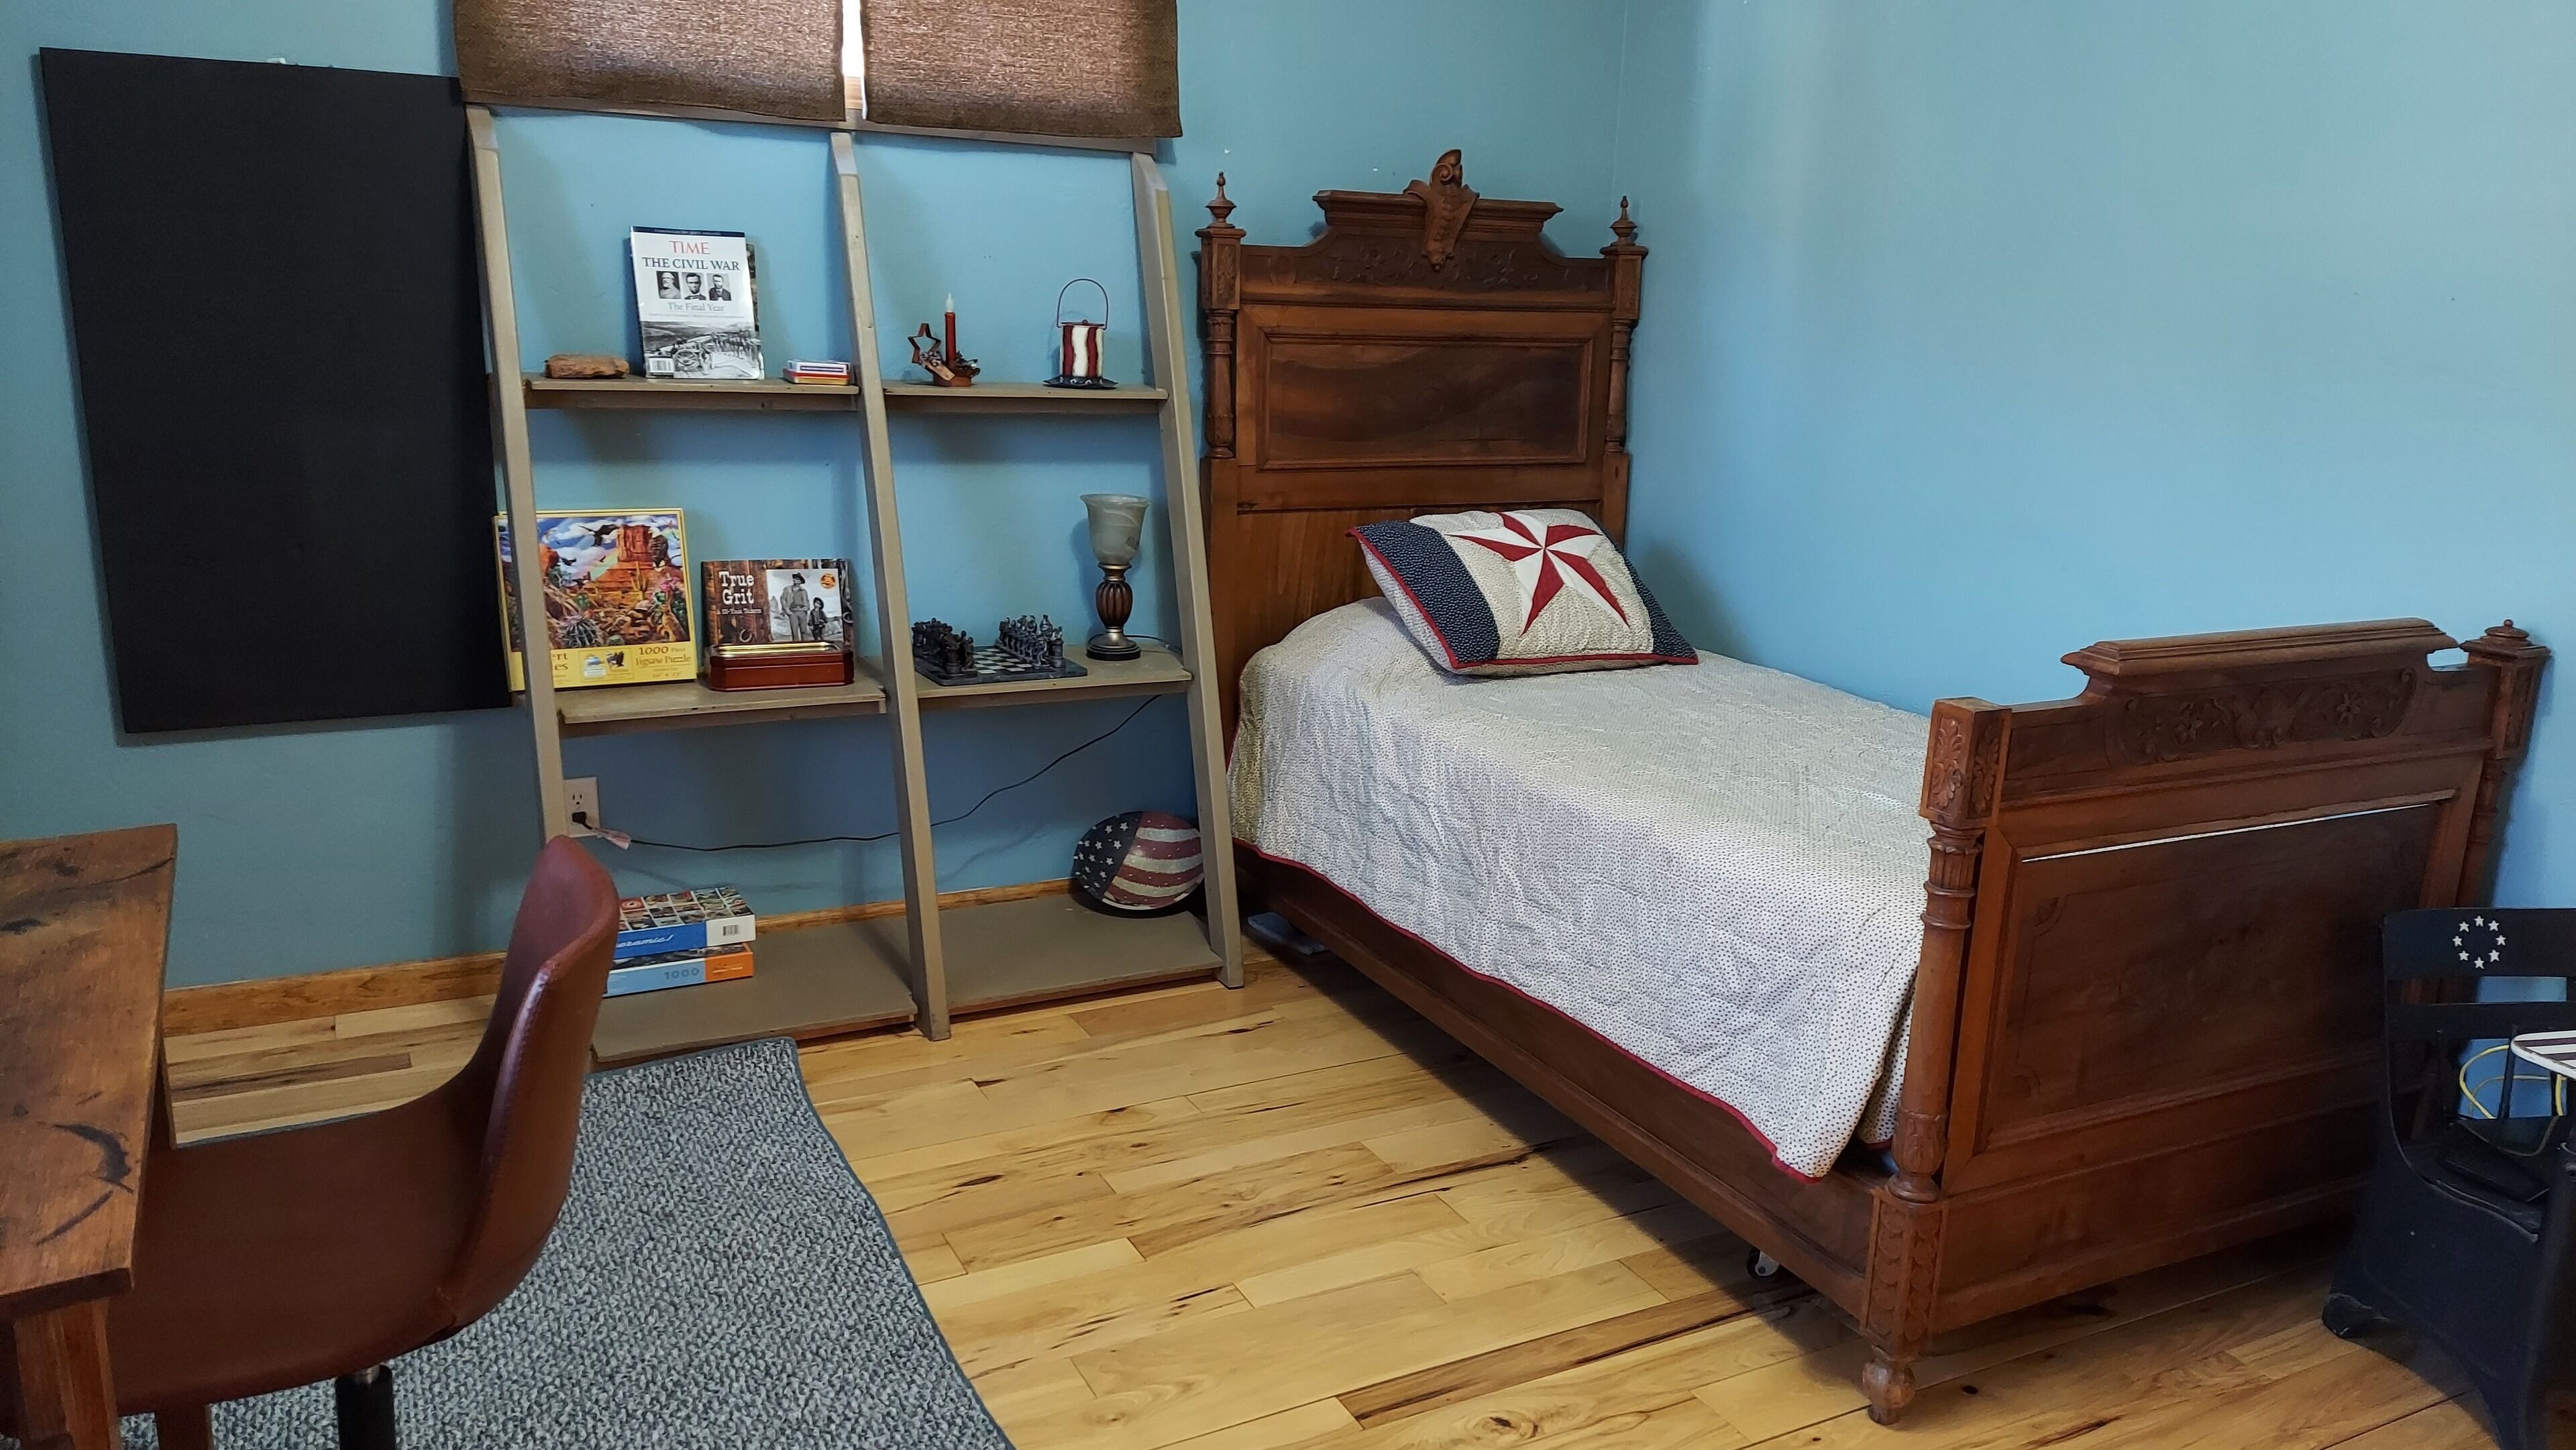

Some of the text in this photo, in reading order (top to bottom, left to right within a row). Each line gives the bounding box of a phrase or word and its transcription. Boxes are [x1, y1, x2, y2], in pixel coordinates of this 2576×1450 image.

[669, 241, 710, 255] TIME
[642, 257, 741, 271] THE CIVIL WAR
[668, 302, 724, 312] The Final Year
[718, 571, 755, 587] True
[722, 589, 754, 605] Grit
[639, 646, 669, 655] 1000
[665, 967, 700, 980] 1000
